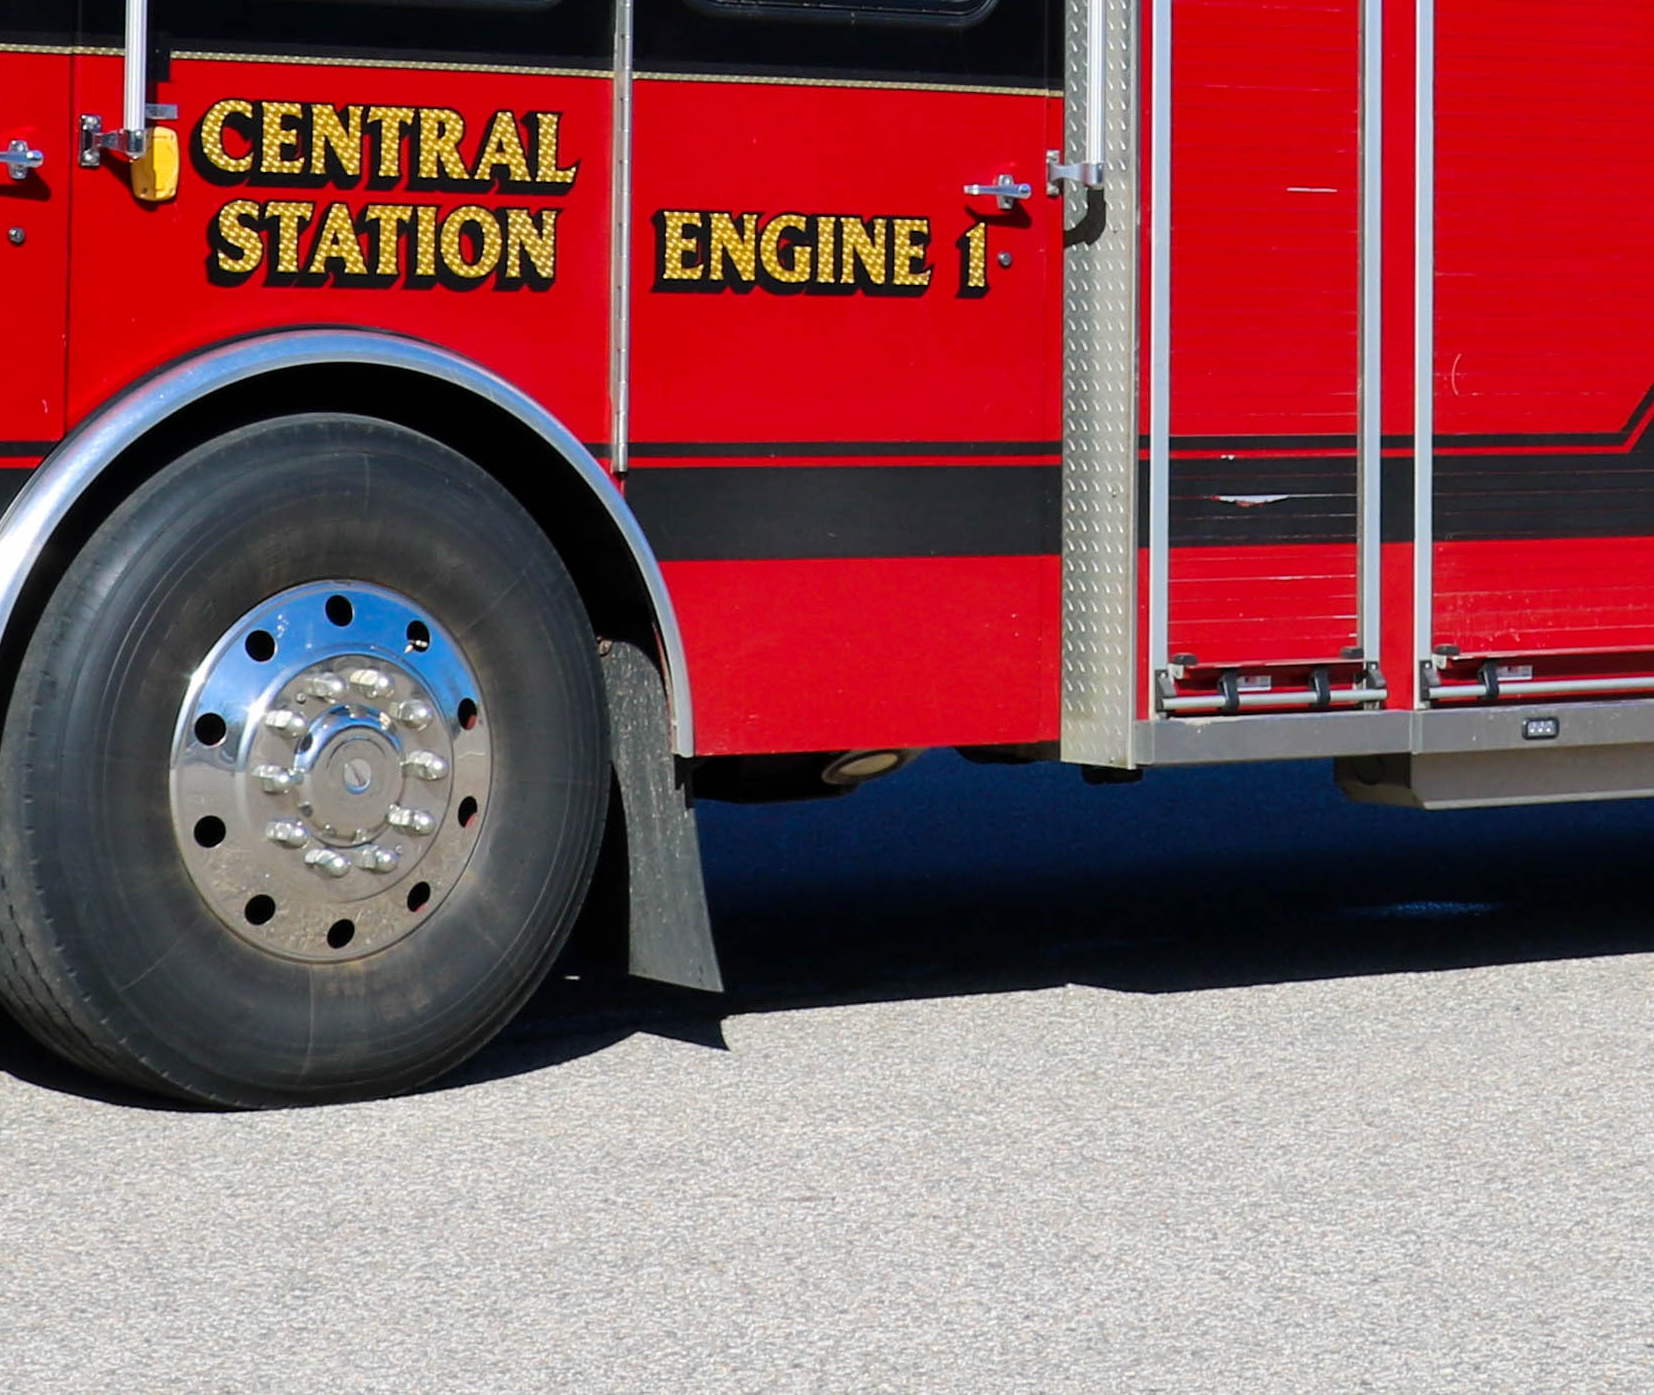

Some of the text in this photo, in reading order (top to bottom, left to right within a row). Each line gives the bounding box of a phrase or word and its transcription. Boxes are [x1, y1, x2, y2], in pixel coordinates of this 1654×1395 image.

[197, 99, 579, 187] CENTRAL
[213, 199, 559, 283] STATION
[659, 210, 987, 291] ENGINE 1
